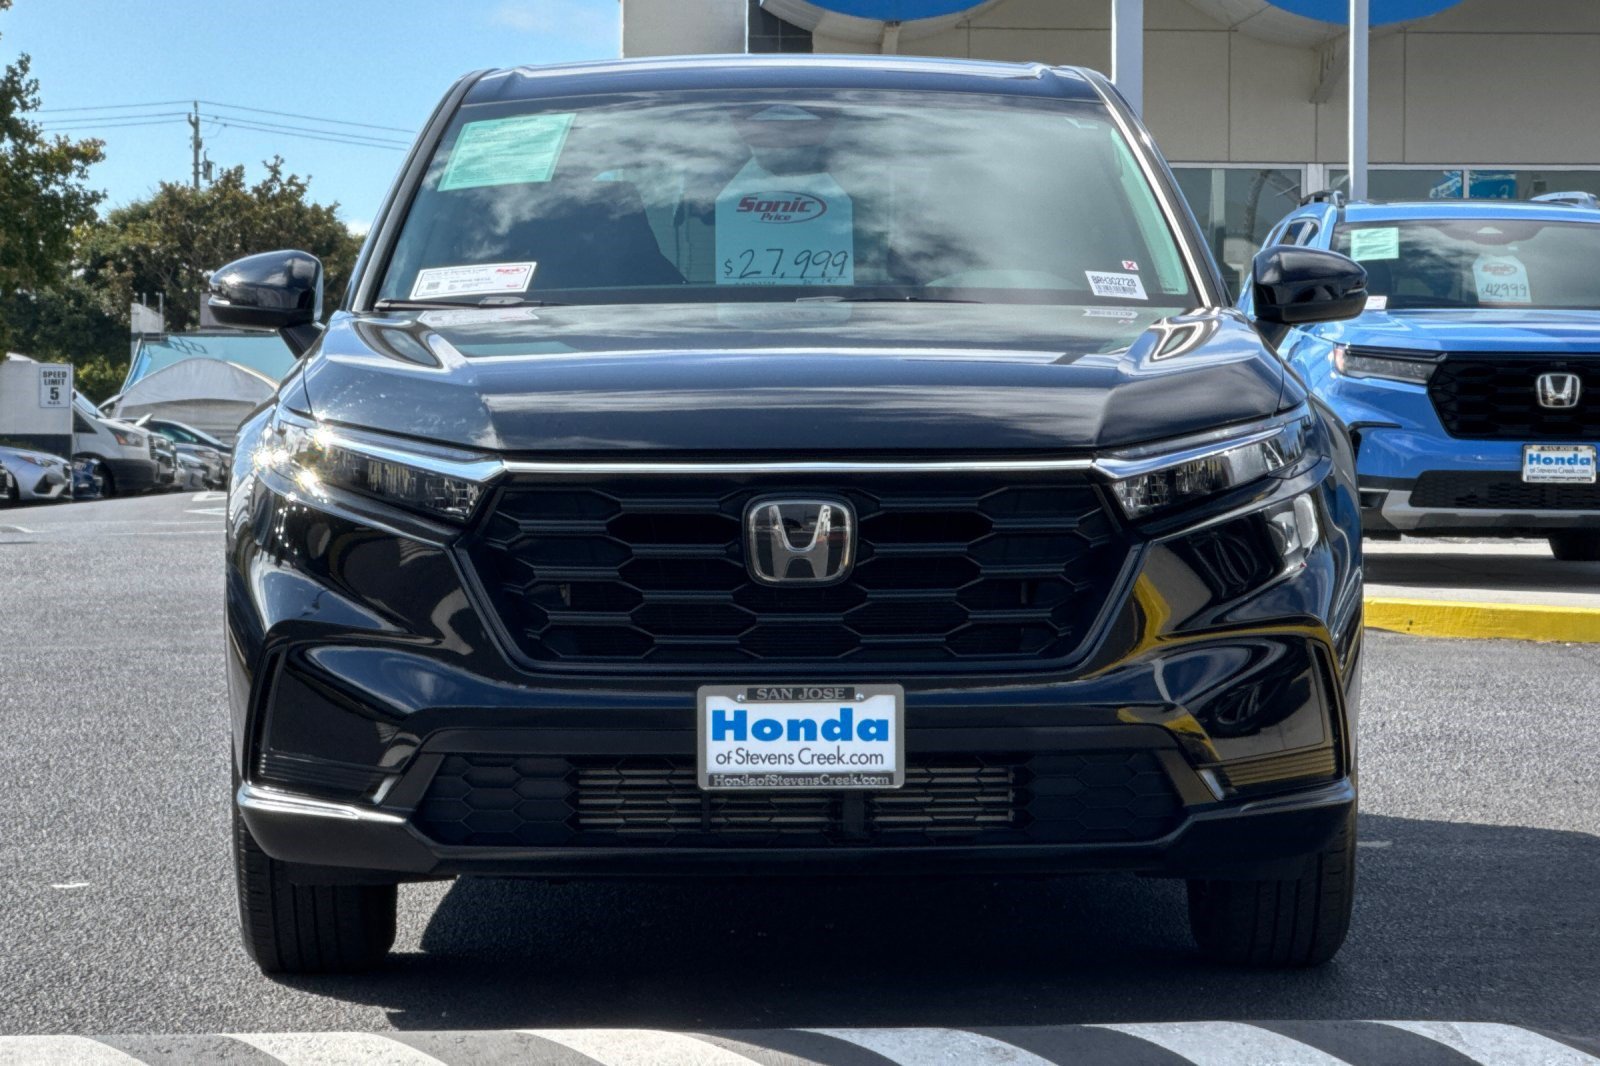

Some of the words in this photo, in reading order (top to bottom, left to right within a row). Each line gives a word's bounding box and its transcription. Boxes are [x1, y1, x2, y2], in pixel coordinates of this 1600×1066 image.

[736, 196, 815, 213] Sonic
[760, 212, 791, 221] Price
[50, 387, 59, 400] 5
[1528, 453, 1591, 466] Honda
[756, 688, 794, 700] SAN
[798, 687, 846, 700] JOSE
[712, 708, 889, 742] Honda
[715, 750, 731, 765] of
[735, 747, 794, 765] Stevens
[798, 745, 884, 765] Creek.com
